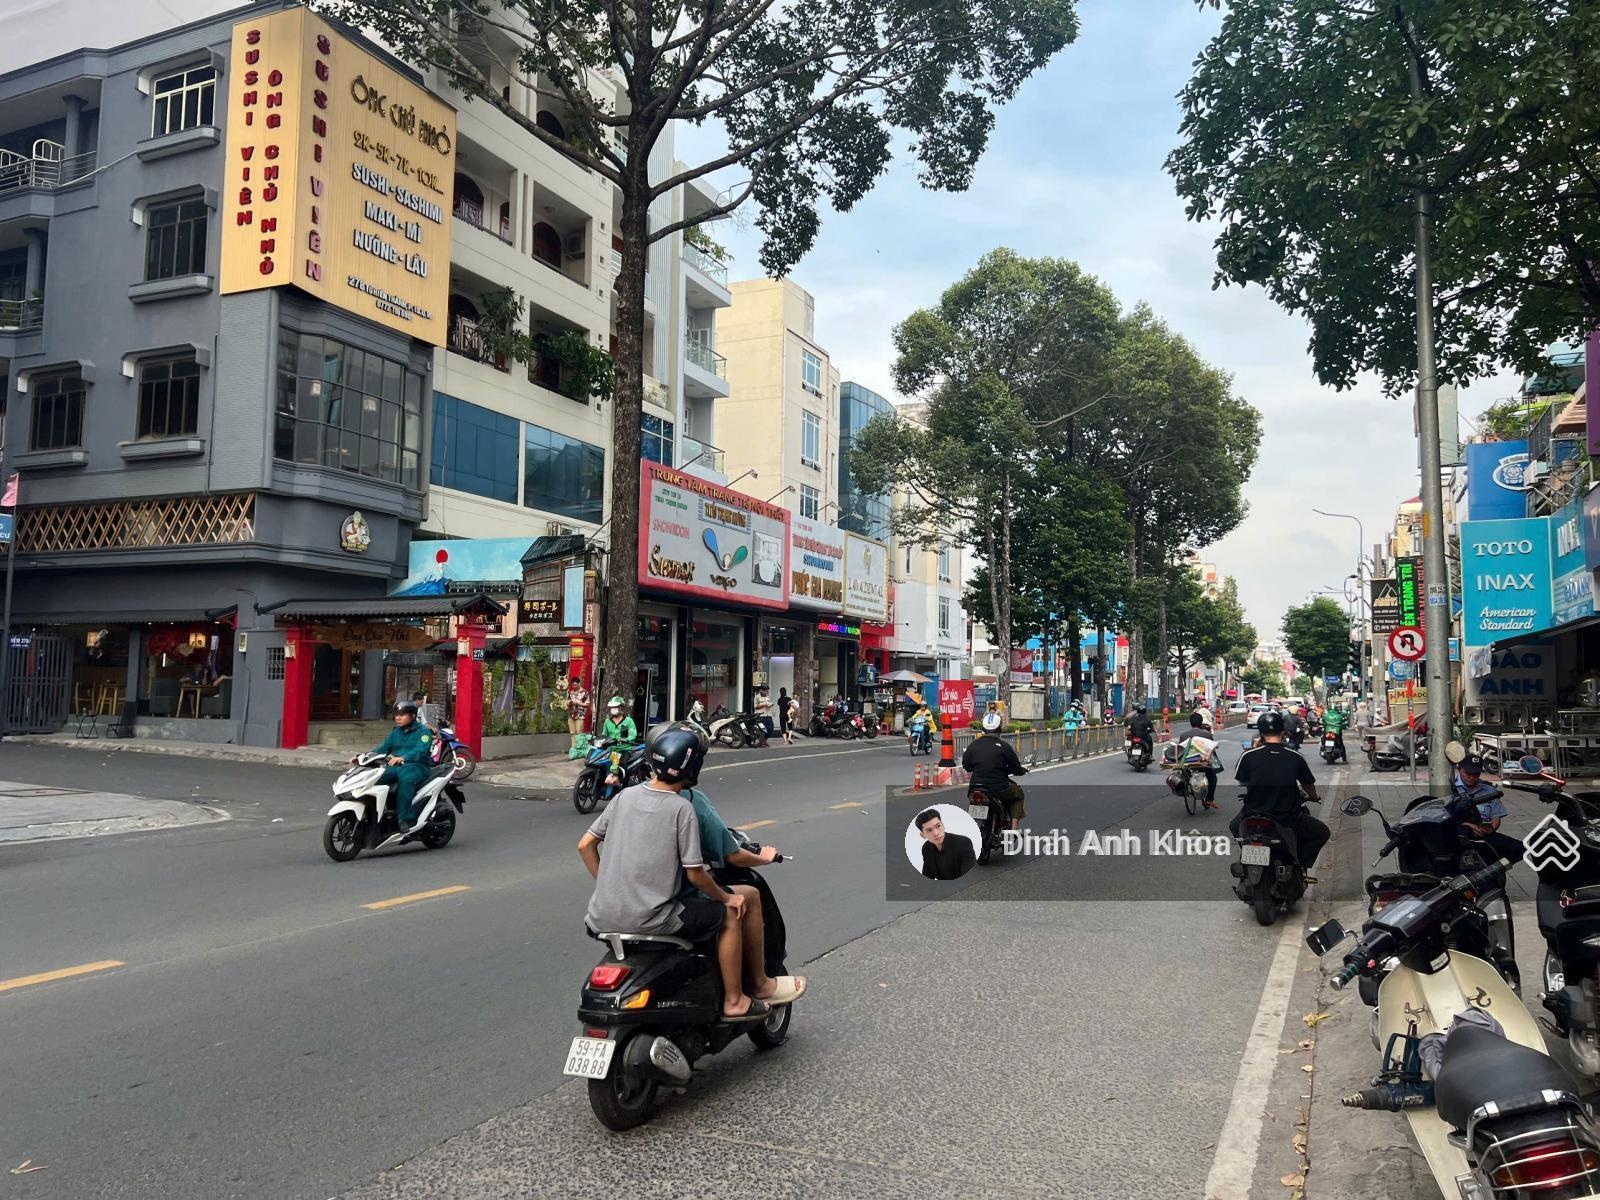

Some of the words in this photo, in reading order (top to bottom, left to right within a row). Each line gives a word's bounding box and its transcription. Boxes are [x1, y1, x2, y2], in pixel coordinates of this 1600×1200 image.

[243, 29, 261, 127] SUSHI
[313, 34, 331, 163] SUSHI
[263, 145, 279, 202] CHỦ
[236, 146, 254, 226] VIÊN
[306, 175, 324, 281] VIÊN
[365, 200, 398, 232] MAKI
[259, 218, 277, 275] NHỎ
[649, 467, 684, 487] TRUNG
[687, 479, 708, 495] TÂM
[708, 487, 736, 505] TRANG
[1473, 540, 1533, 556] TOTO
[1399, 564, 1412, 579] TRÍ
[1477, 573, 1535, 591] INAX
[1402, 580, 1414, 611] TRANG
[1480, 606, 1536, 618] American
[1480, 618, 1534, 630] Standard
[473, 649, 484, 658] 278
[1479, 679, 1544, 695] ANH
[576, 1041, 607, 1058] 59-FA
[568, 1057, 605, 1075] 038.88
